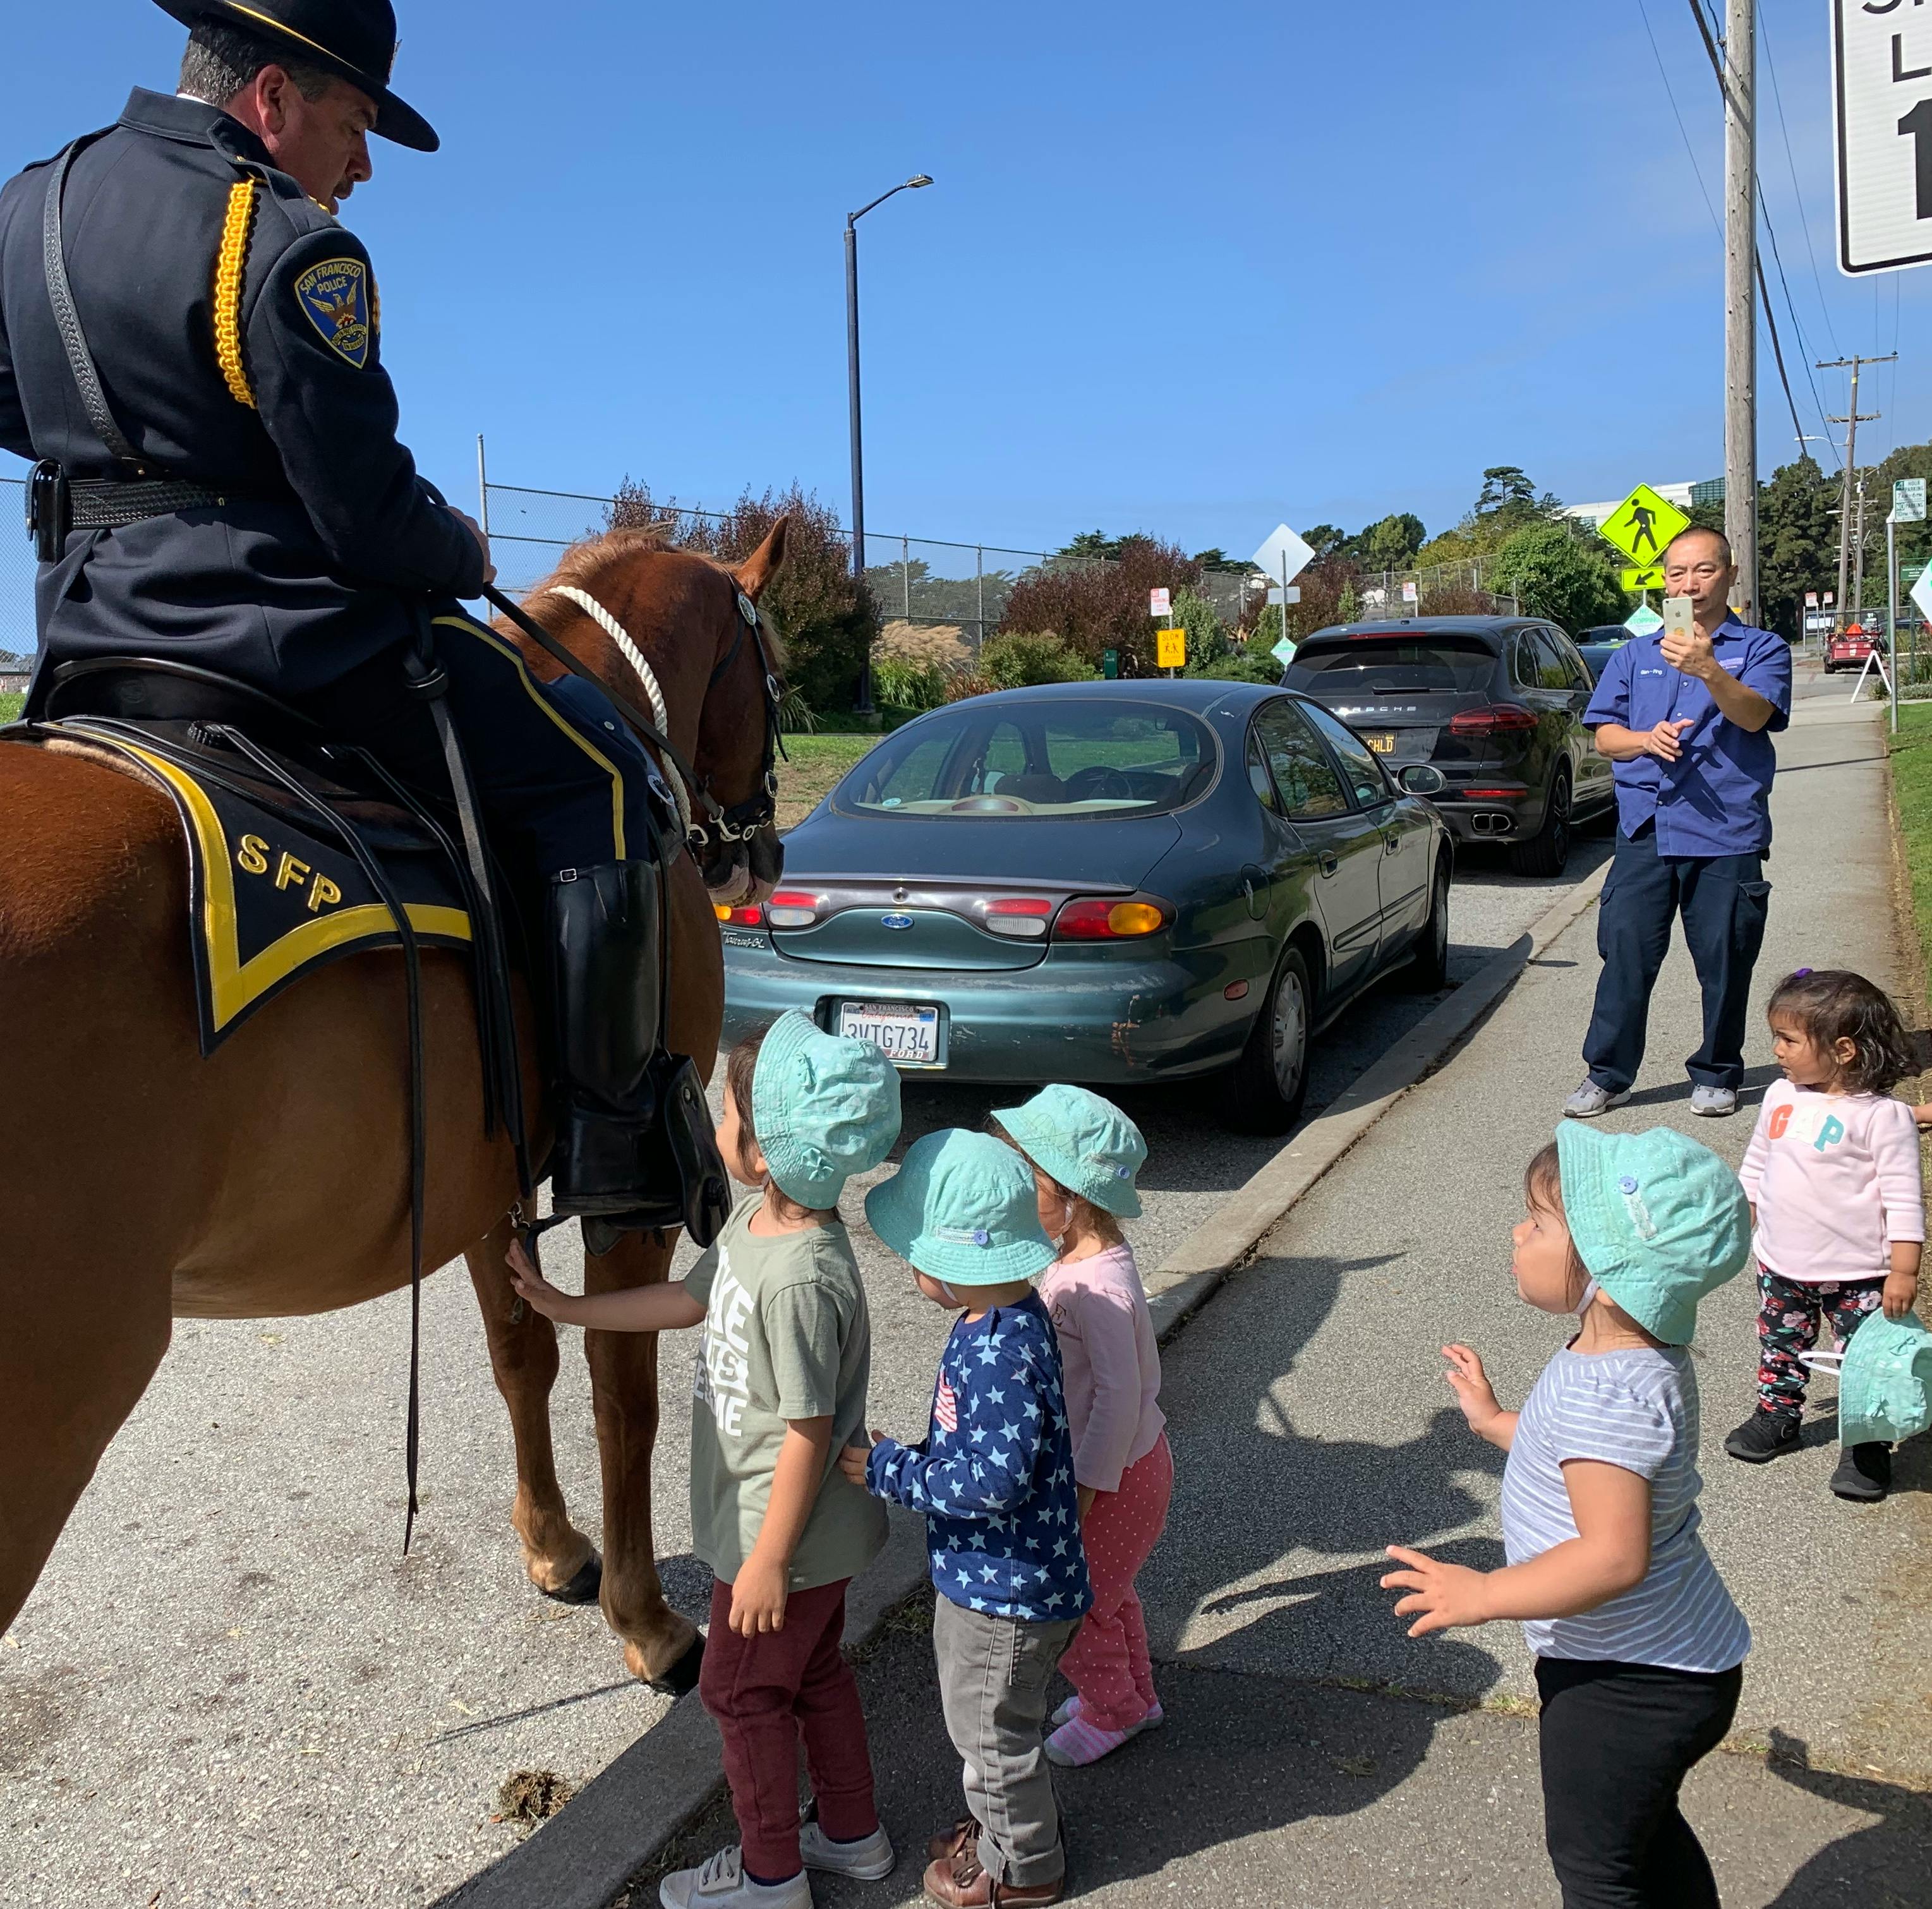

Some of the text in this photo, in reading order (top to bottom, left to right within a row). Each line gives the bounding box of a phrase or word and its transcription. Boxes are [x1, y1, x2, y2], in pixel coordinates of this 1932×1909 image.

[300, 263, 361, 295] SAN FRANCISCO
[317, 276, 347, 295] POLICE
[1629, 616, 1660, 625] STOPPING
[1162, 633, 1180, 641] SLOW
[879, 1004, 914, 1013] FRANCISCO
[848, 1023, 929, 1051] 3VTG734
[889, 1049, 924, 1059] FORD
[1769, 1104, 1844, 1152] GAP
